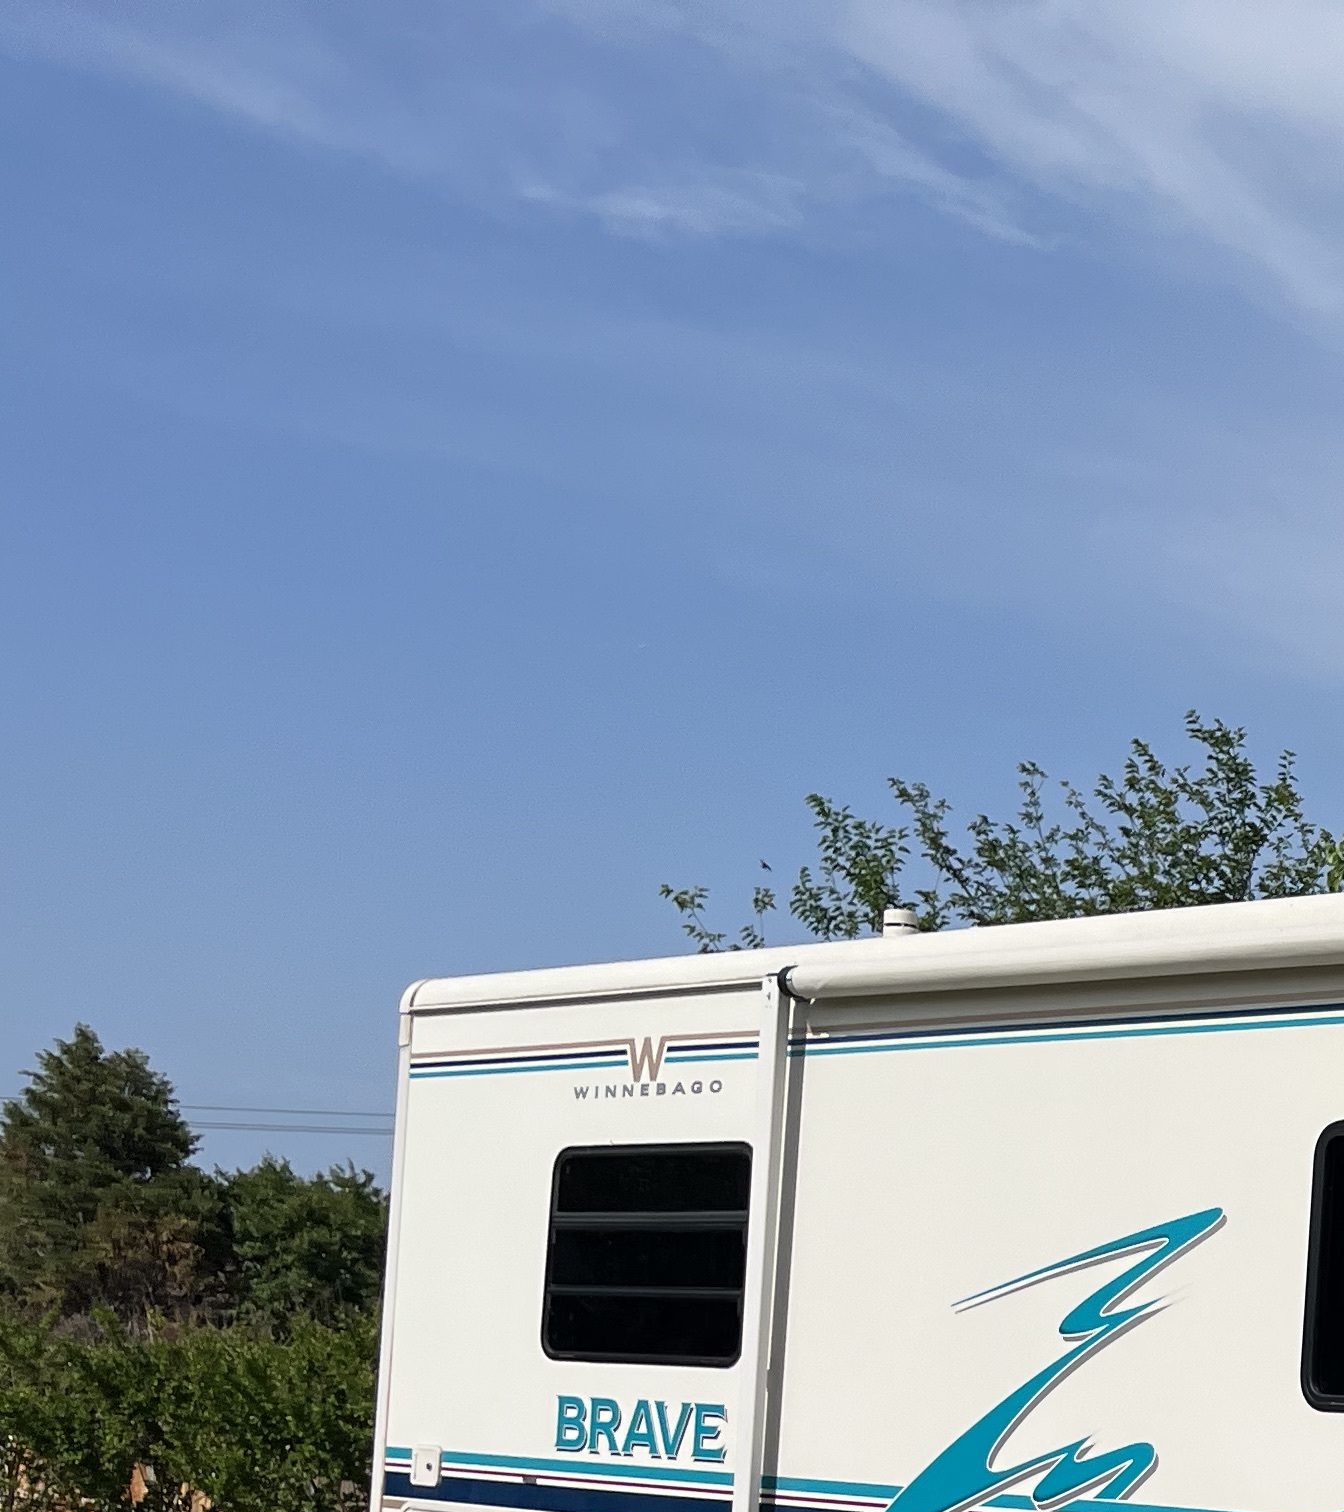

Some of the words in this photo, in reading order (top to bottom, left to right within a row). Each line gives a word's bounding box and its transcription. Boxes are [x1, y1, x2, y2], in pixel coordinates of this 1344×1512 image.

[627, 1036, 667, 1082] W
[573, 1079, 723, 1100] WINNEBAGO
[554, 1394, 729, 1464] BRAVE
